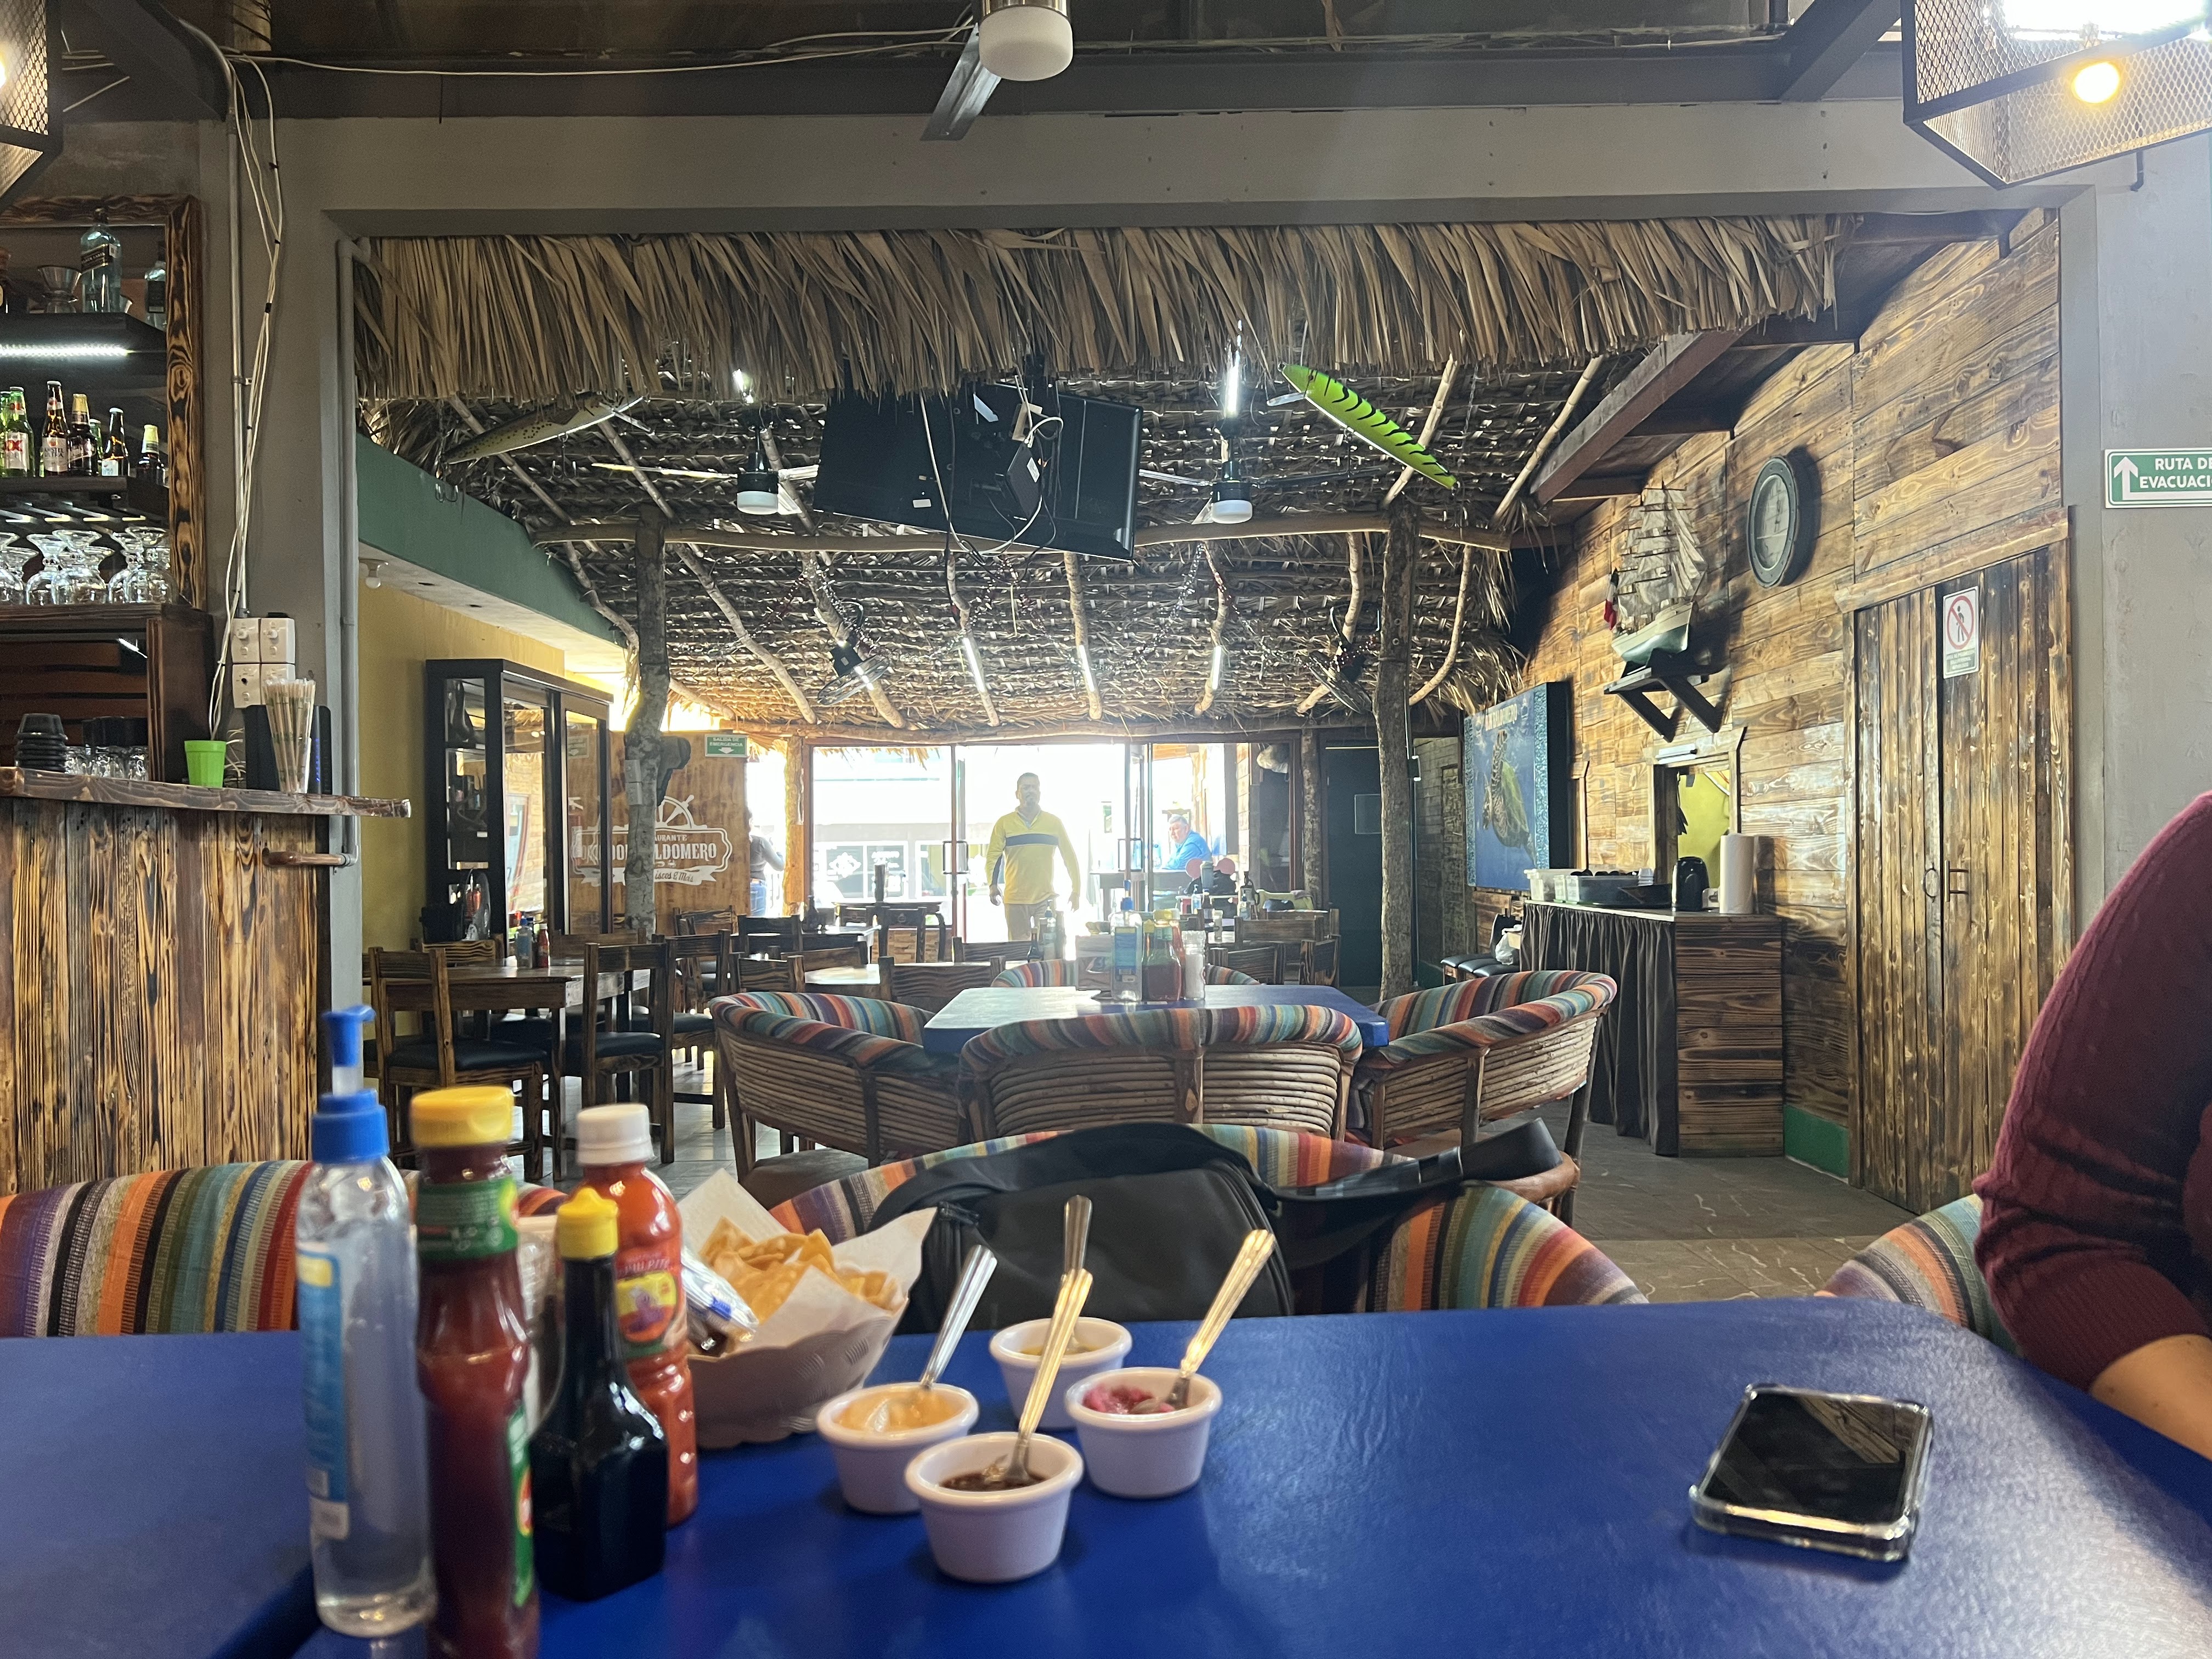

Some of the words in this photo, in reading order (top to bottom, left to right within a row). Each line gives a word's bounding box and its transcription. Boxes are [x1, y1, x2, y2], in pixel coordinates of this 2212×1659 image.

[2155, 458, 2193, 470] RUTA
[2197, 457, 2212, 470] DE
[2140, 475, 2212, 488] EVACUACI
[654, 843, 716, 861] LDOMERO
[655, 870, 672, 879] iscos
